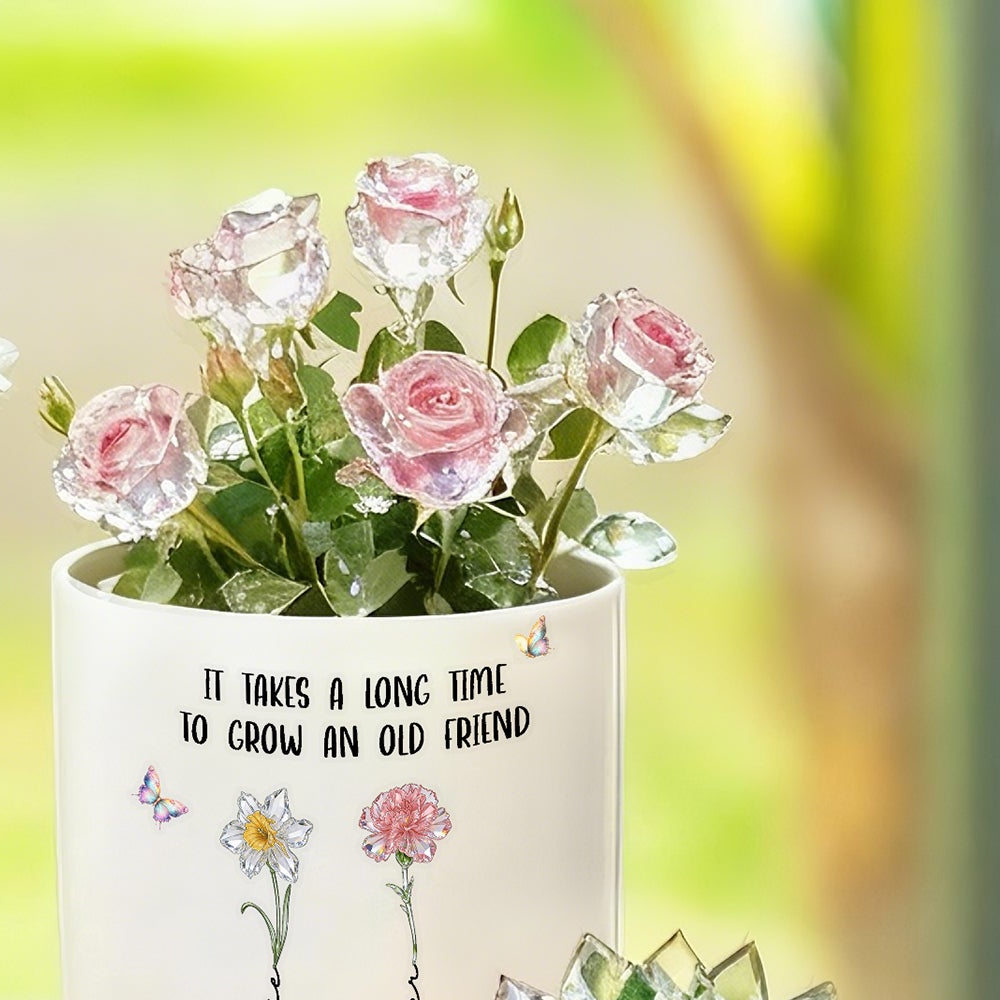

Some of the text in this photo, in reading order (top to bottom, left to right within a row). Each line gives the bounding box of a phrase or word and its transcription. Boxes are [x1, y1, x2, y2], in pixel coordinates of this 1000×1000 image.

[203, 663, 508, 711] IT TAKES A LONG TIME
[179, 705, 530, 759] TO GROW AN OLD FRIEND
